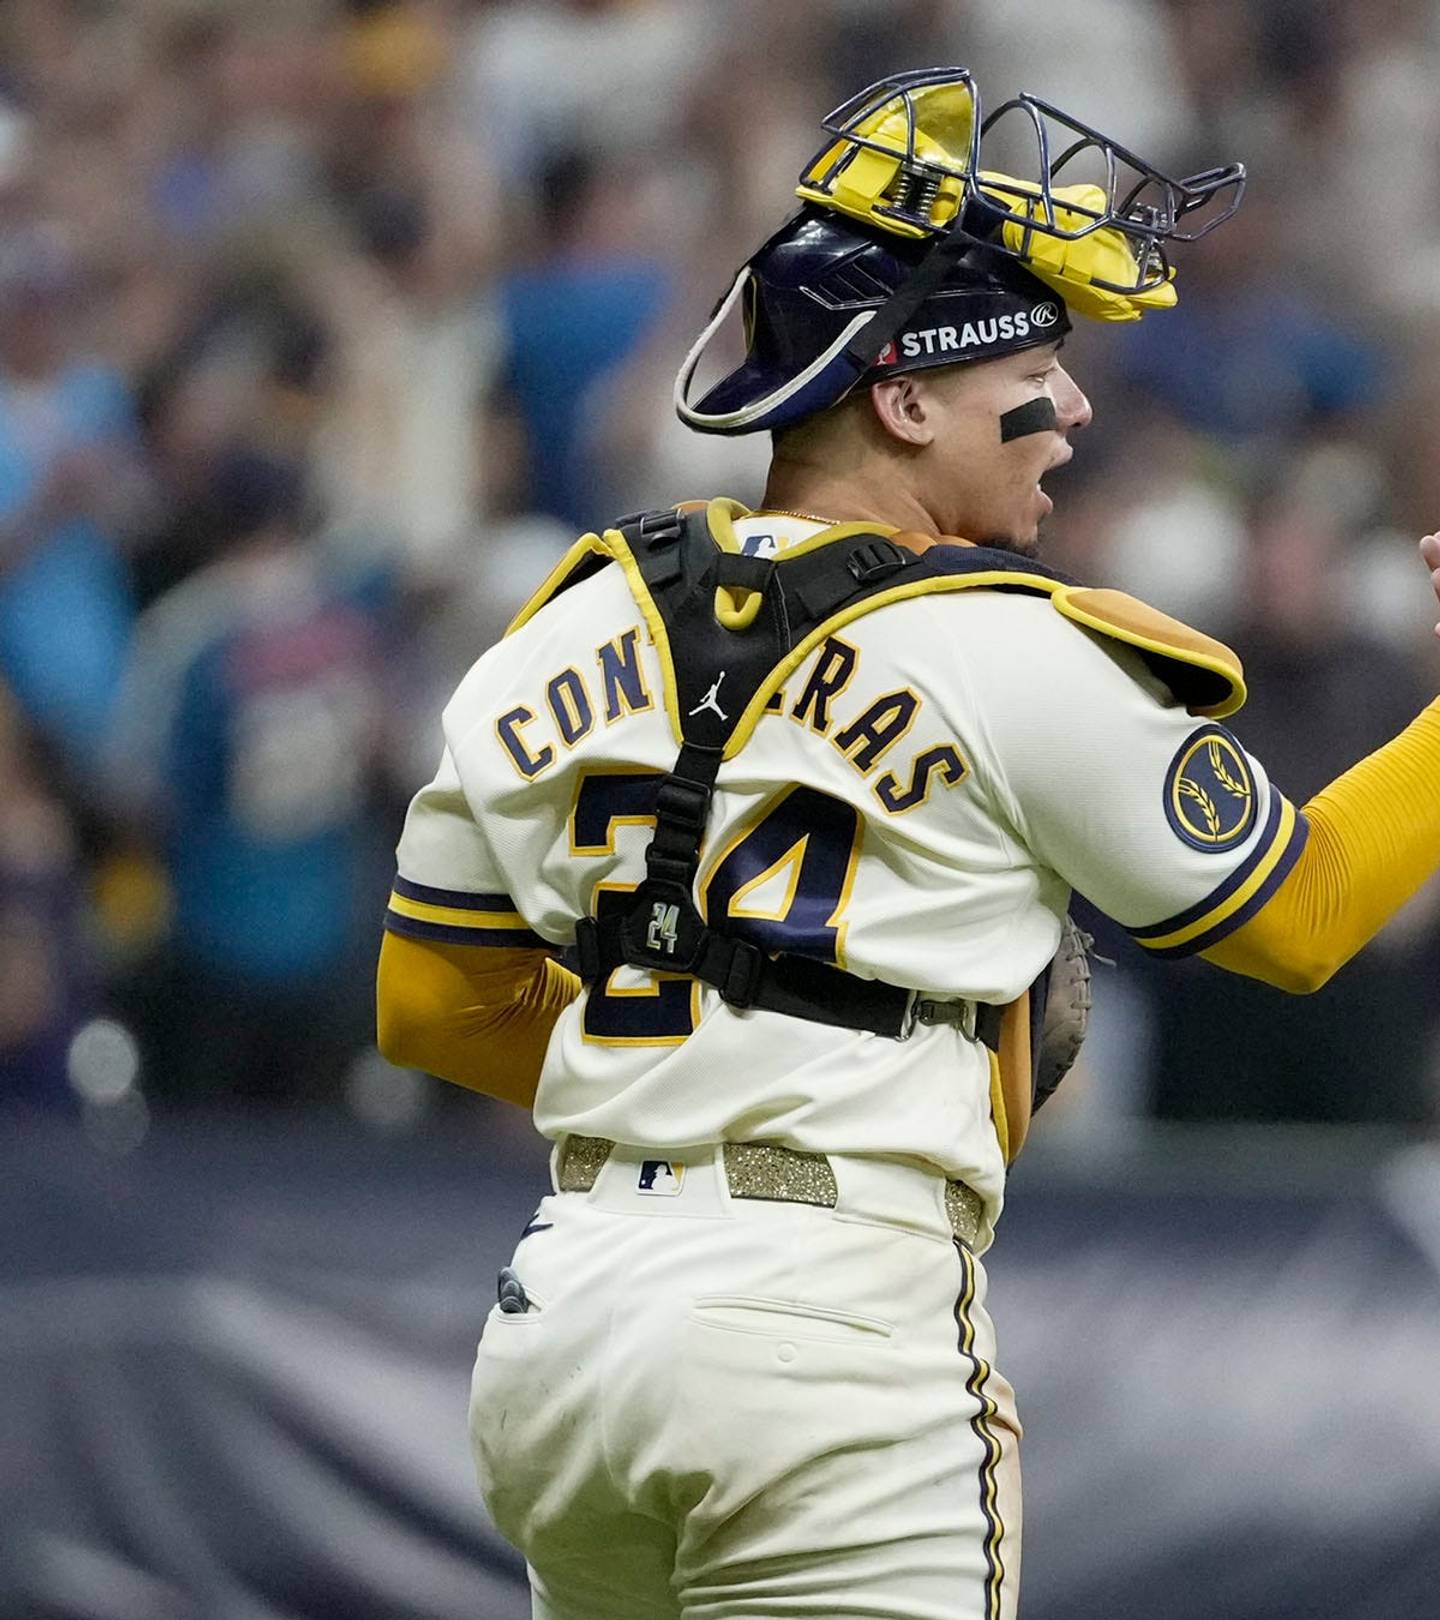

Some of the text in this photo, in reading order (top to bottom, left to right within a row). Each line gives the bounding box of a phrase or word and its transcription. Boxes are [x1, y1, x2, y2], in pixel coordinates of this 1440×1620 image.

[902, 312, 1030, 357] STRAUSS
[494, 625, 972, 817] CONRAS
[568, 766, 866, 1048] 24
[647, 902, 680, 954] 24
